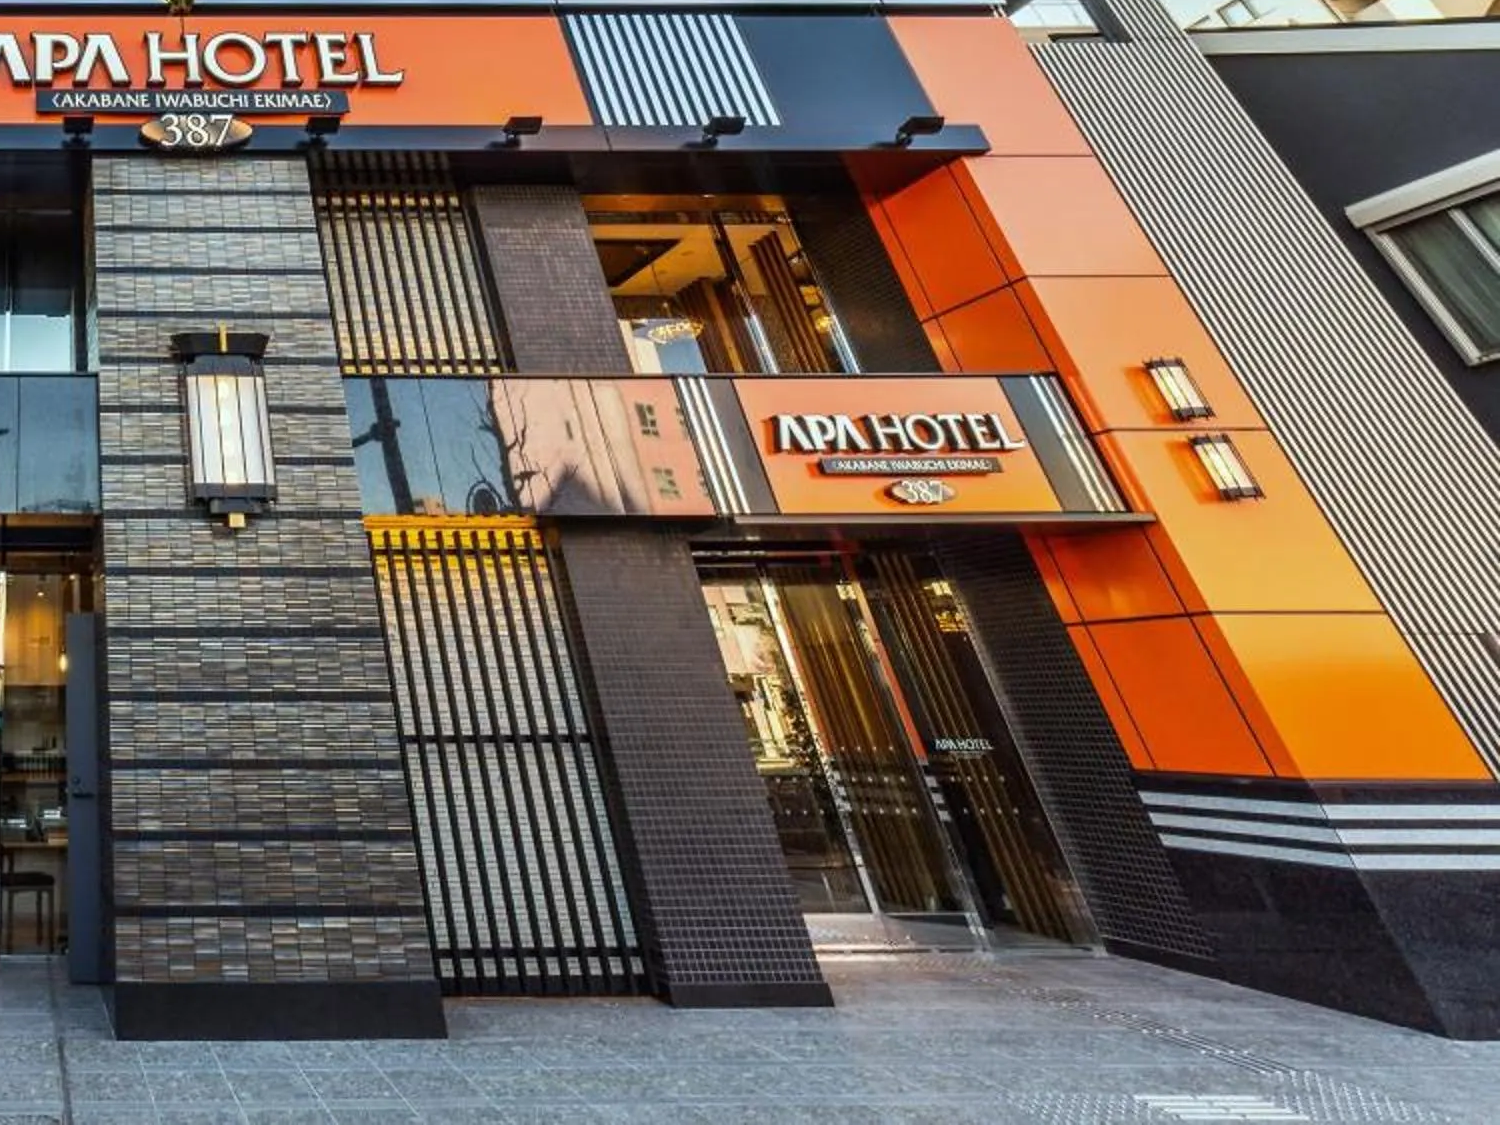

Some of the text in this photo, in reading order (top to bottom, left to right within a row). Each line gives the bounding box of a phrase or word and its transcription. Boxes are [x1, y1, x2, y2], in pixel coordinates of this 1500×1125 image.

[144, 31, 405, 87] HOTEL
[155, 92, 249, 110] IWABUCHI
[160, 114, 234, 148] 387
[777, 413, 1027, 451] APA HOTEL
[902, 480, 943, 504] 387
